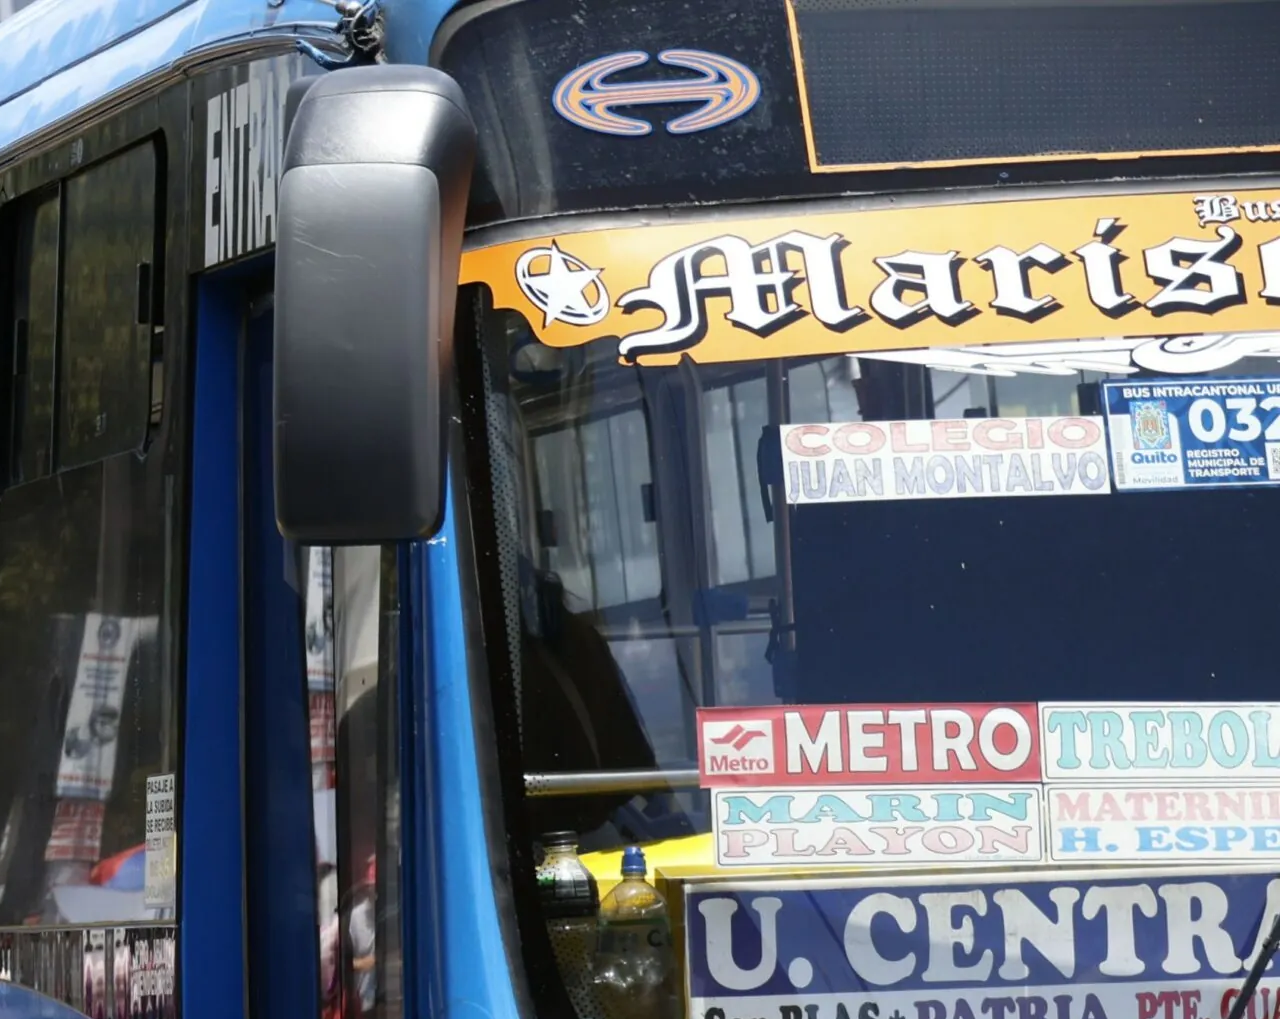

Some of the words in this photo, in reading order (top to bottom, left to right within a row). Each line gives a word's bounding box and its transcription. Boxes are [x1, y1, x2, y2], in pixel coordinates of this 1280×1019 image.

[1123, 387, 1150, 398] BUS
[1153, 384, 1264, 397] INTRACANTONAL
[785, 417, 1101, 457] COLEGIO
[1131, 451, 1177, 465] Quito
[1186, 448, 1240, 458] REGISTRO
[1188, 458, 1247, 469] MUNICIPAL
[1250, 457, 1265, 467] DE
[788, 456, 884, 503] JUAN
[893, 451, 1107, 496] MONTALVO
[1132, 475, 1179, 485] Movilidad
[1189, 467, 1260, 478] TRANSPORTE
[783, 707, 1033, 775] METRO
[1047, 709, 1280, 771] TREBOL
[710, 755, 769, 773] Metro
[146, 780, 168, 795] PASAJE
[146, 801, 153, 815] LA
[154, 799, 173, 814] SUBIDA
[722, 792, 1033, 826] MARIN
[146, 819, 153, 834] SE
[154, 816, 174, 833] RECIBE
[721, 826, 1033, 859] PLAYON
[1058, 826, 1119, 852] H.
[698, 896, 813, 990] U.
